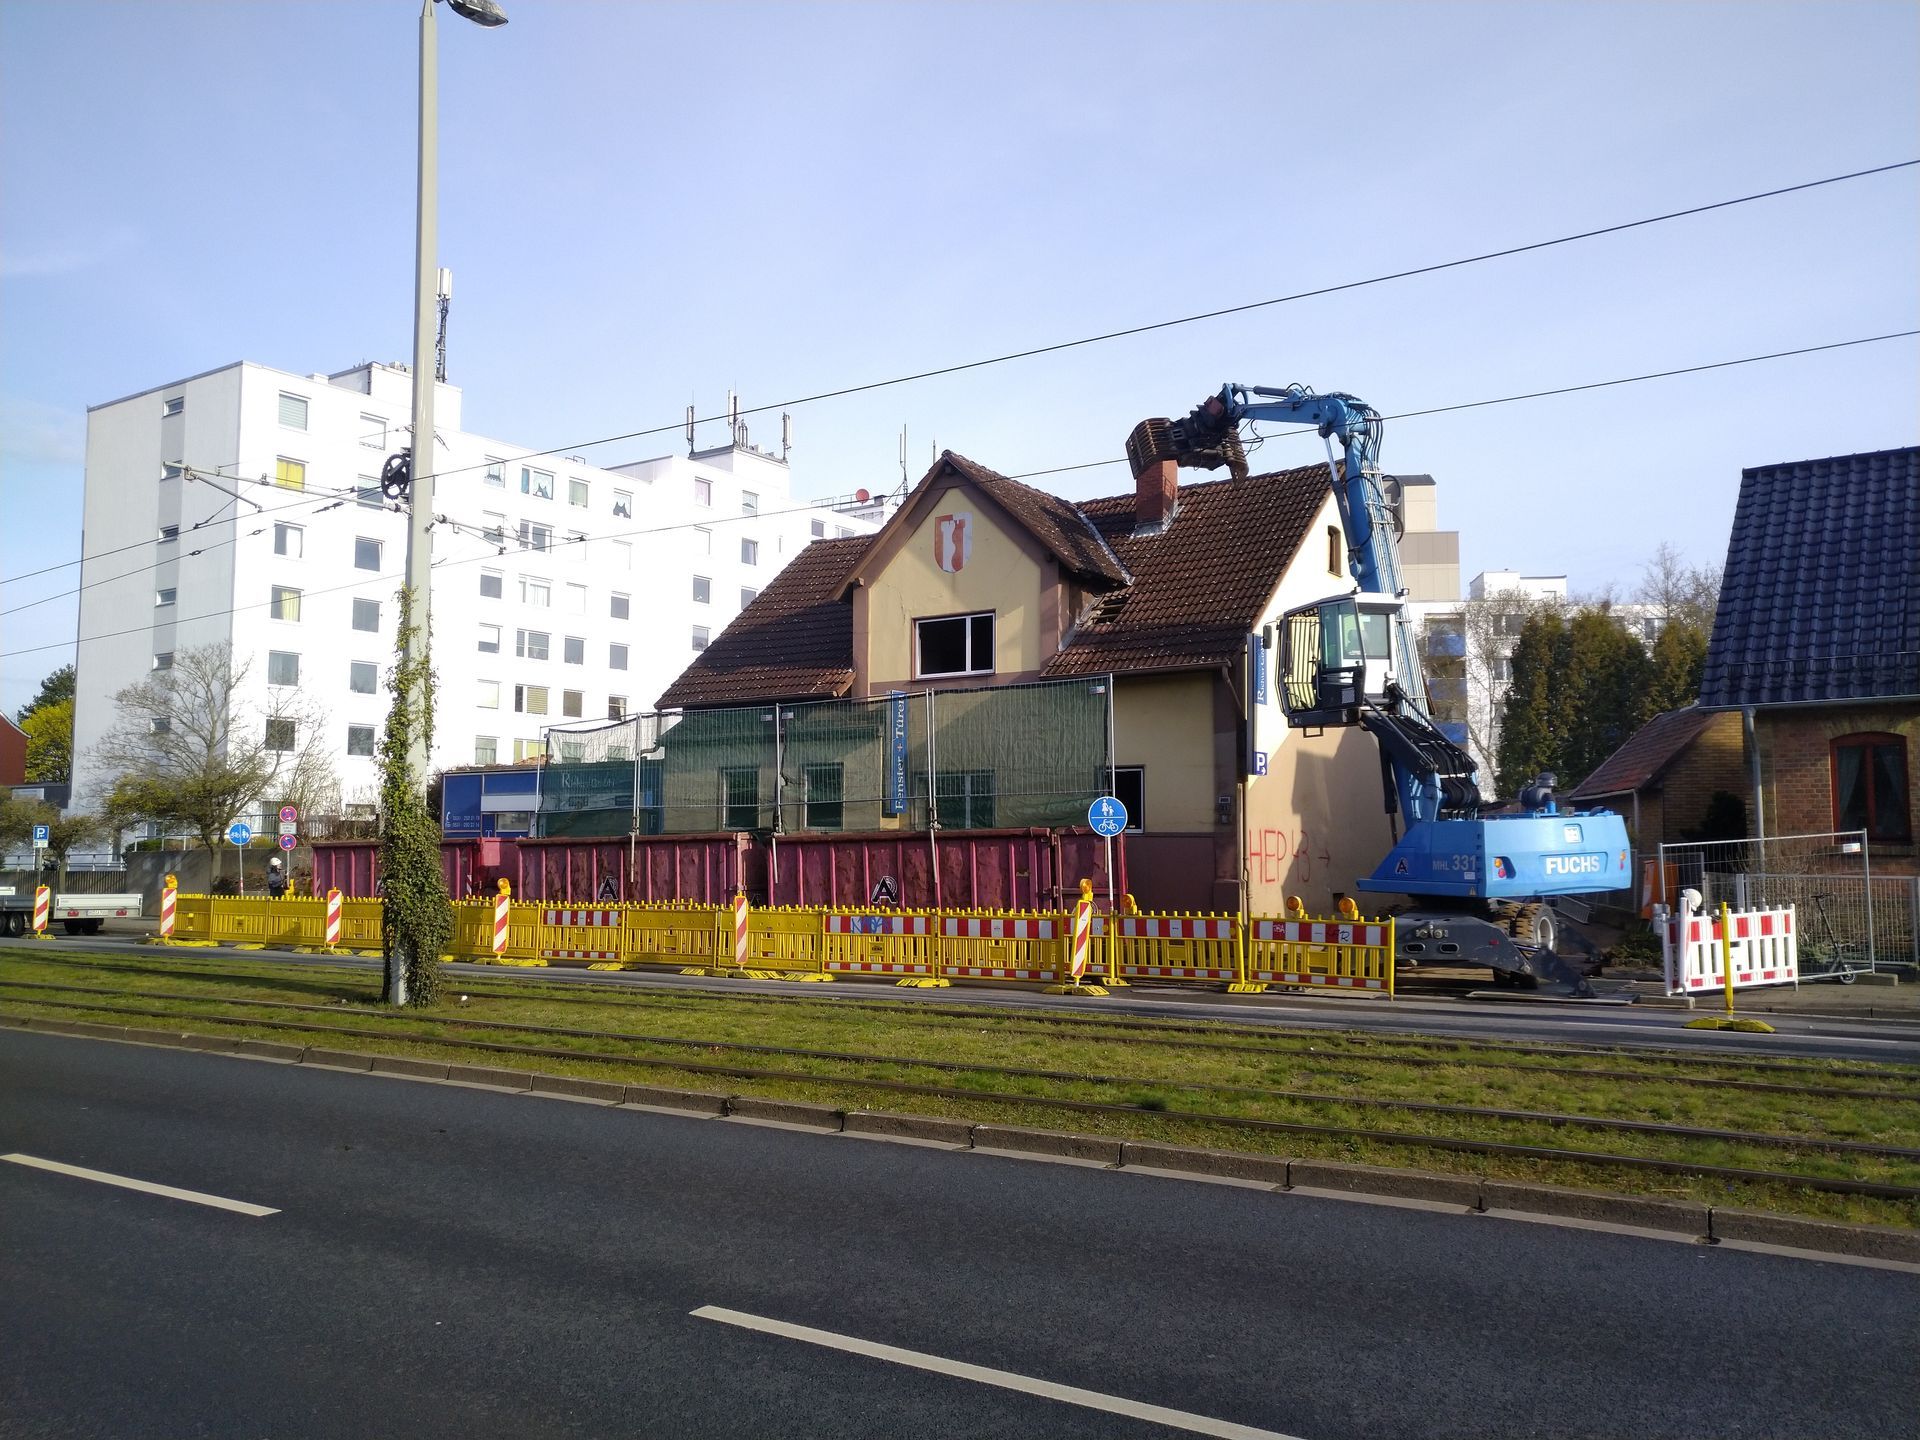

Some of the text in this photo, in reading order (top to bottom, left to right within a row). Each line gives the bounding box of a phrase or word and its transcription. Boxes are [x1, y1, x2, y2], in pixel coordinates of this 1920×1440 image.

[1257, 753, 1265, 771] P
[895, 756, 904, 810] Fenster
[37, 827, 45, 839] P
[1249, 829, 1287, 884] HEP
[1433, 854, 1476, 871] MHL 331
[1546, 856, 1600, 875] FUCHS
